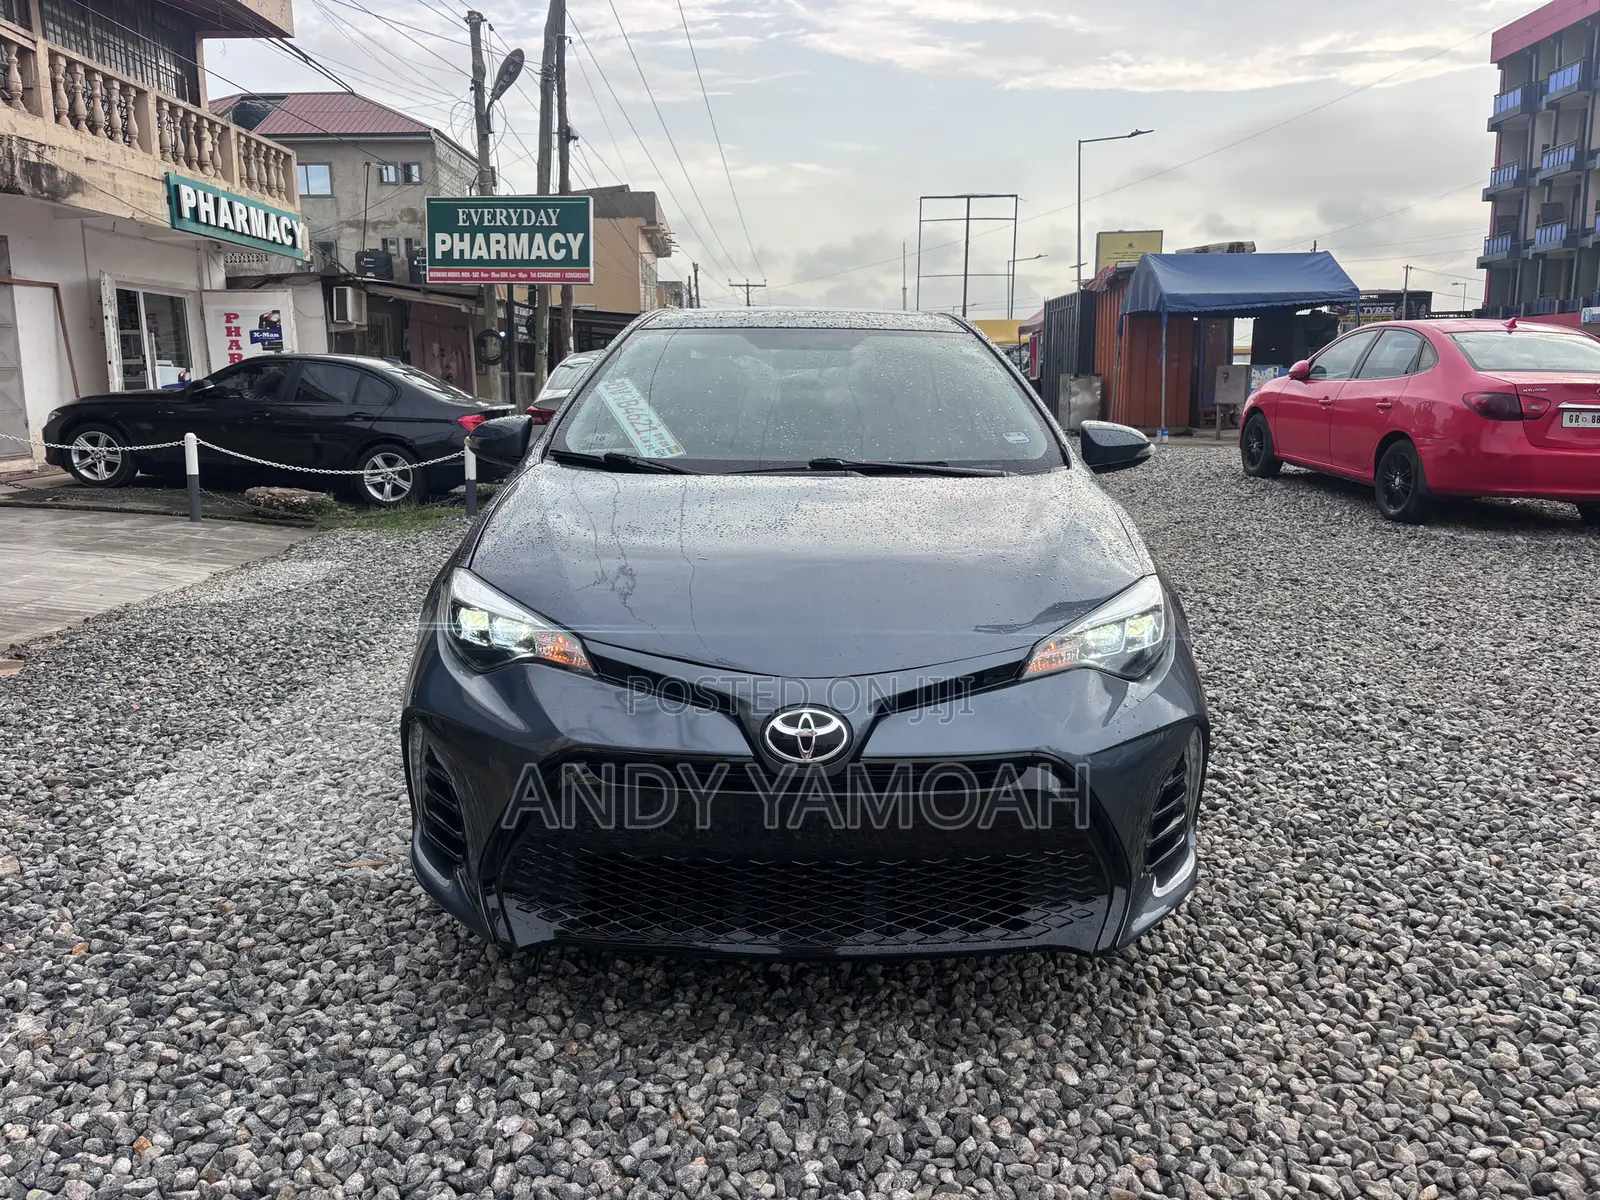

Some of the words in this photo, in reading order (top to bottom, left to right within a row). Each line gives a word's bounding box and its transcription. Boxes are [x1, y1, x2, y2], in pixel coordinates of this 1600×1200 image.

[179, 184, 303, 250] PHARMACY
[457, 208, 561, 227] EVERYDAY
[435, 232, 585, 261] PHARMACY
[1363, 306, 1395, 314] TYRES
[1569, 414, 1580, 424] GR
